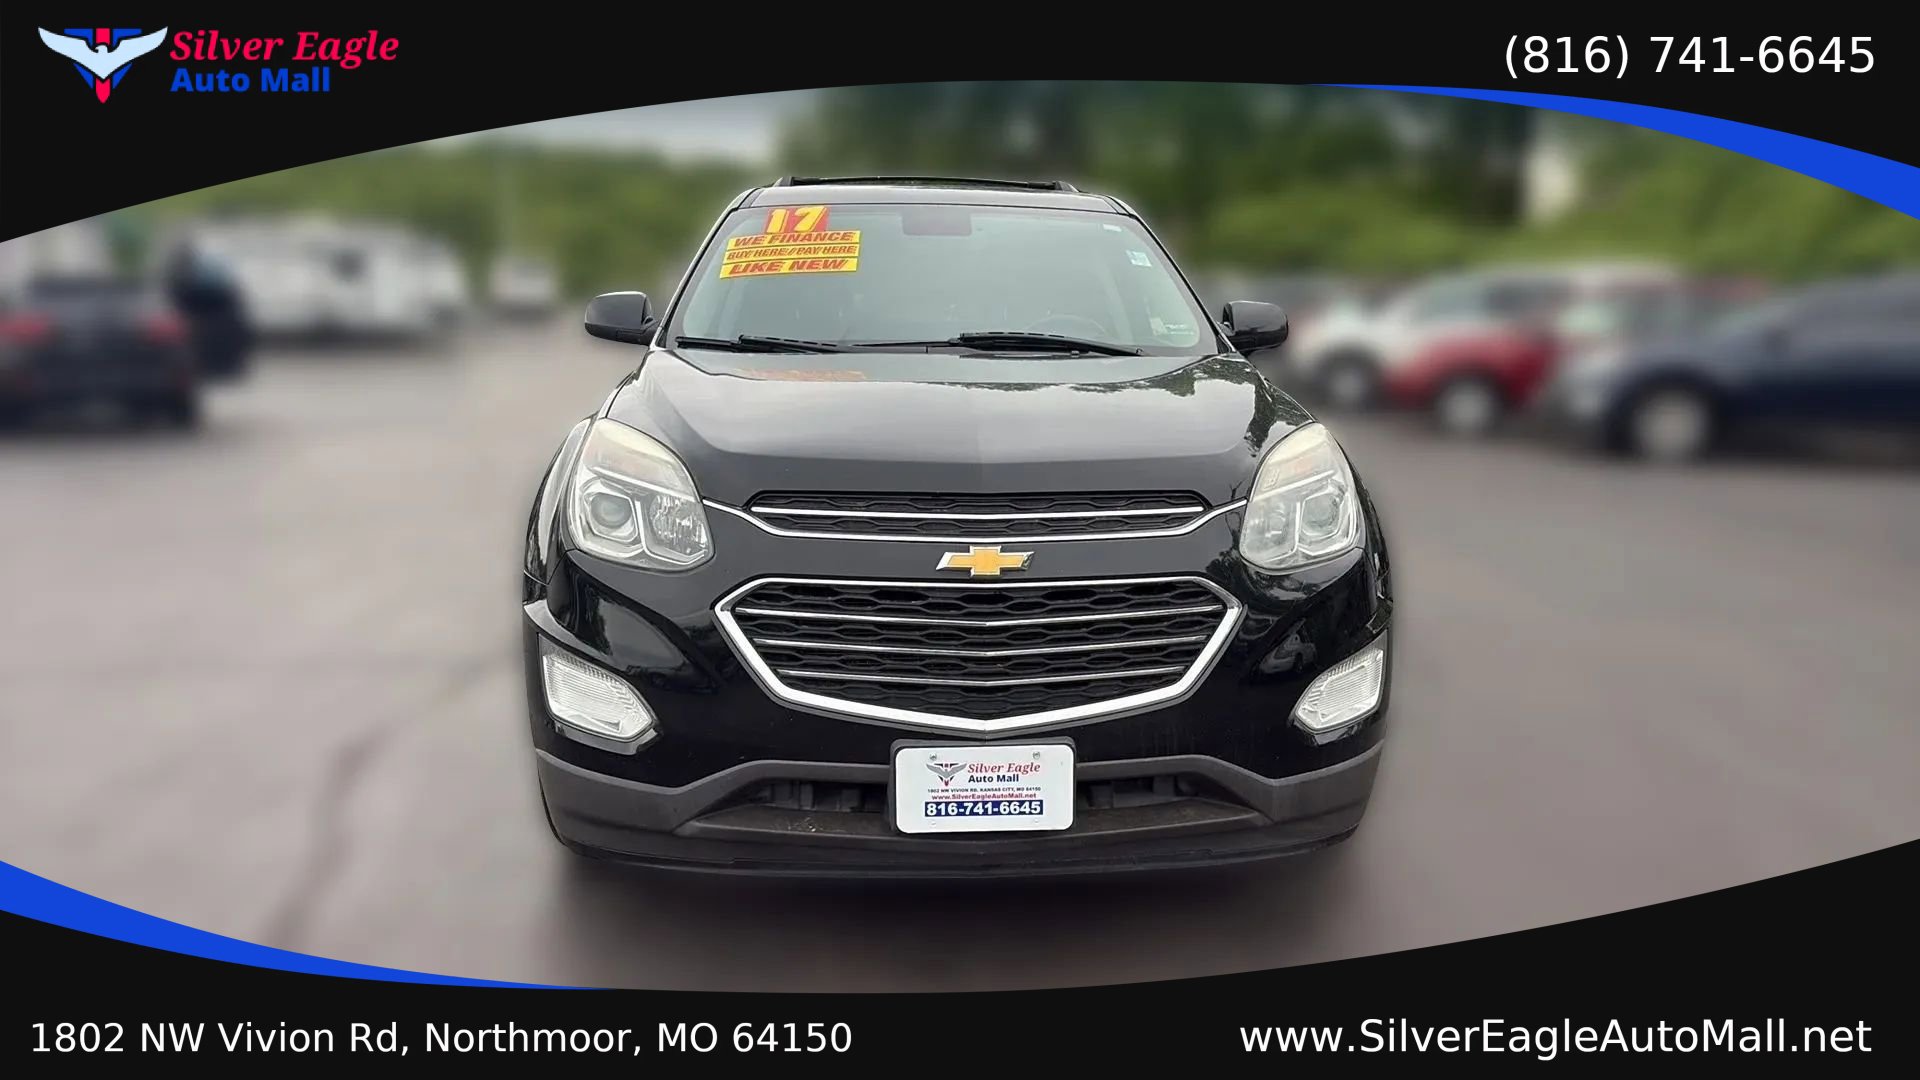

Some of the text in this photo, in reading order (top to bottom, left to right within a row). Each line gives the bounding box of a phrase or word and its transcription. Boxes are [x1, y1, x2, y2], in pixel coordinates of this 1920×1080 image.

[766, 205, 828, 234] 17
[734, 231, 857, 247] WE FINANCE
[823, 245, 858, 255] HERE
[729, 258, 849, 275] LIKE NEW
[967, 762, 1041, 775] Silver Eagle
[968, 774, 1020, 783] Auto Mall
[931, 793, 1037, 801] www.SilverEagleAutoMall.net
[926, 801, 1041, 816] 816-741-6645
